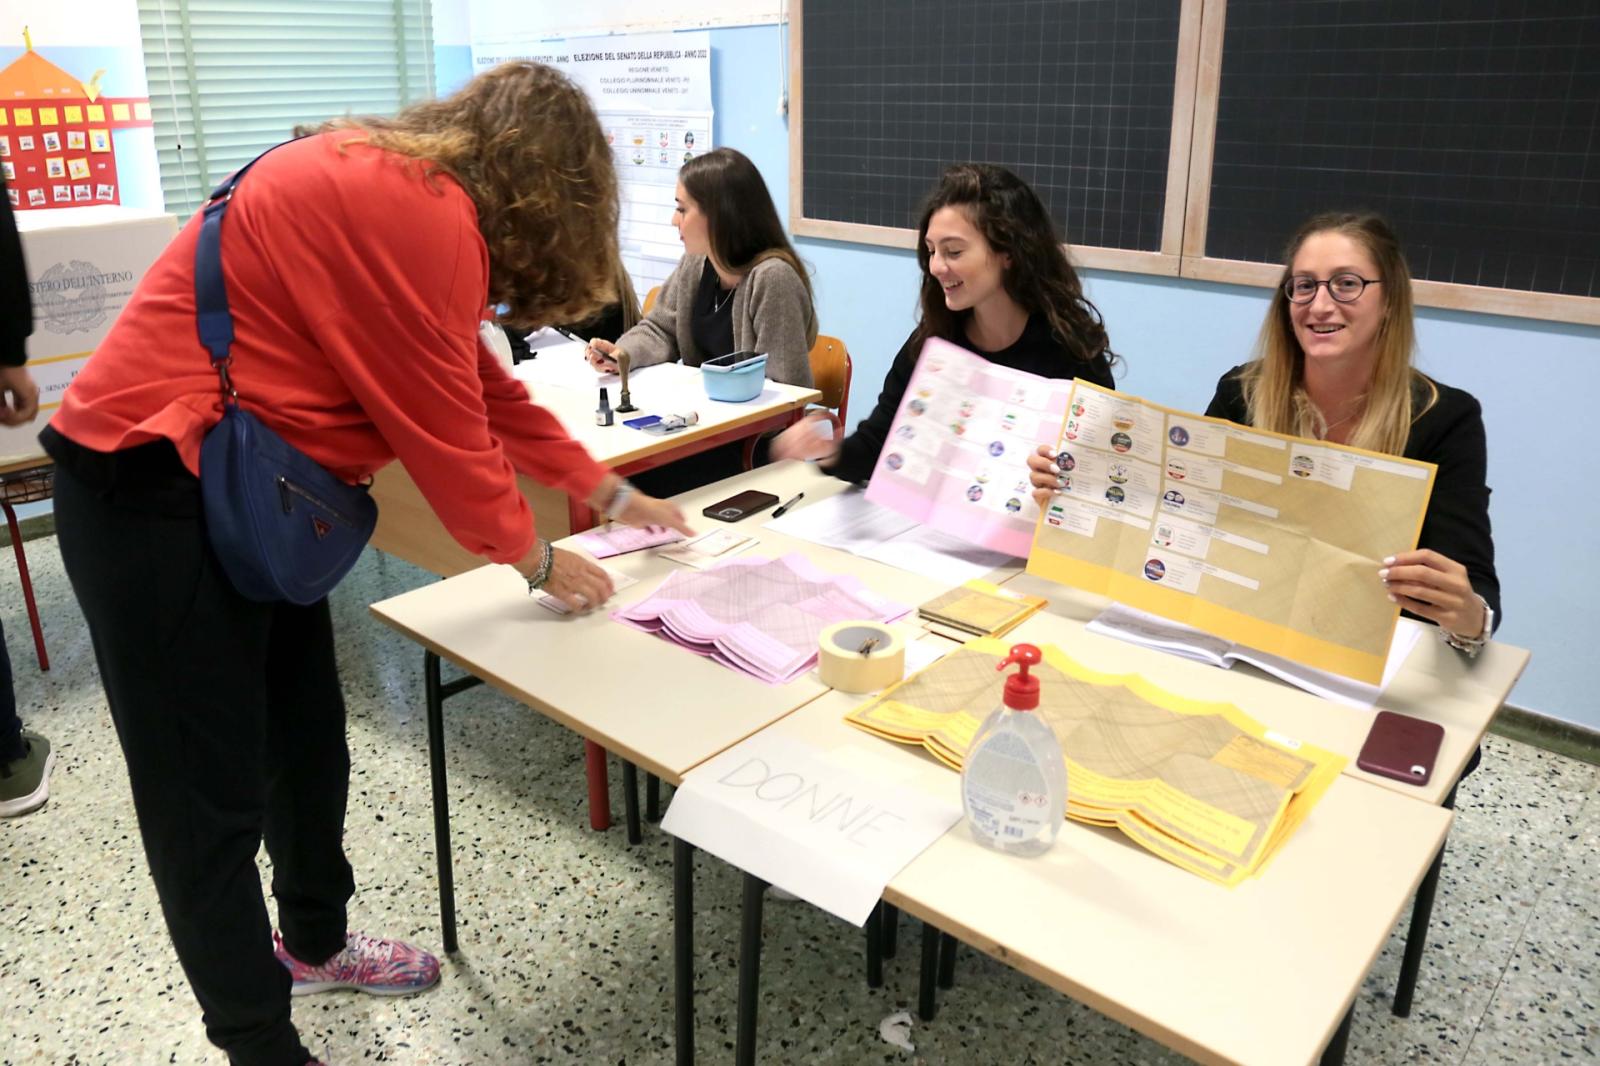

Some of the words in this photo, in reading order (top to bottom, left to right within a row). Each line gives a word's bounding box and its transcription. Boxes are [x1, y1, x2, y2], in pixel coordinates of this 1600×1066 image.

[573, 53, 604, 62] ELEZIONE
[605, 52, 616, 61] DEL
[616, 51, 637, 61] SENATO
[637, 51, 653, 60] DELLA
[653, 50, 682, 59] REPUBBLICA
[684, 49, 697, 59] ANNO
[717, 757, 907, 850] DONNE
